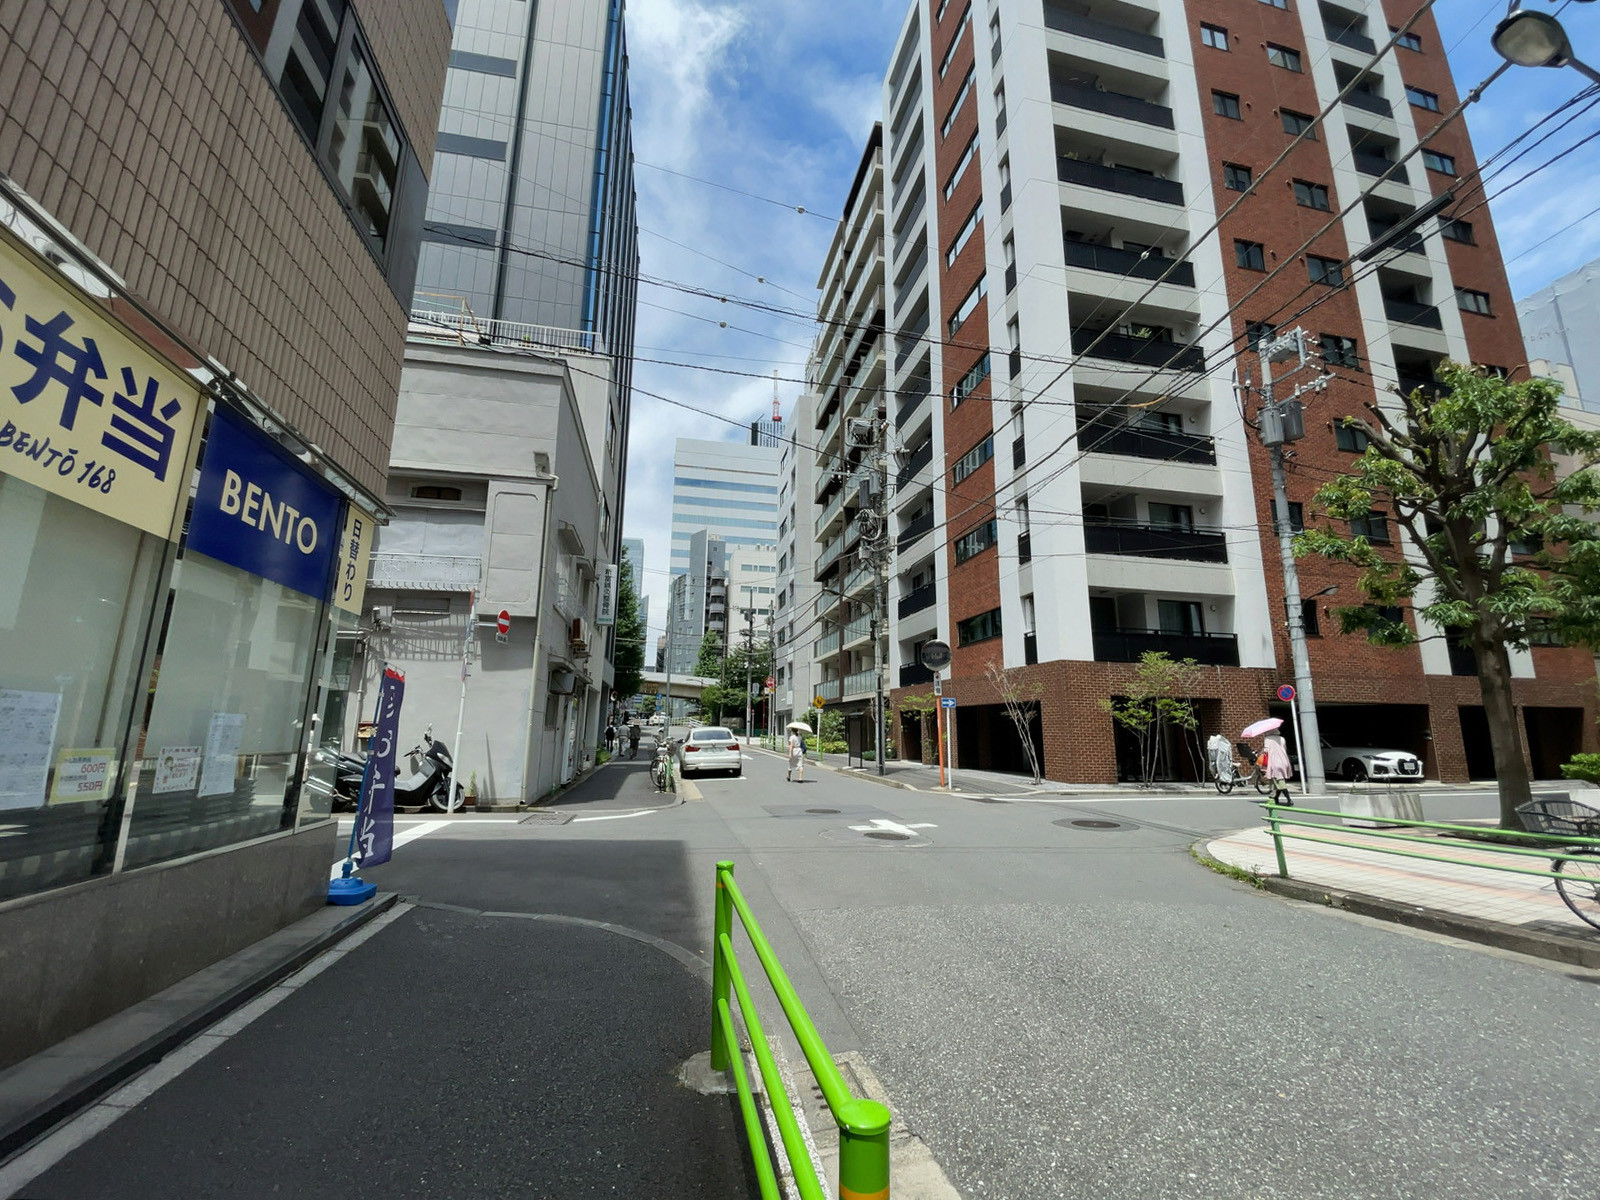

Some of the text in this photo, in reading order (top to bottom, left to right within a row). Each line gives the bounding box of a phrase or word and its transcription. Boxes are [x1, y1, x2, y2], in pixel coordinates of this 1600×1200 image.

[0, 278, 182, 482] 弁当
[77, 460, 116, 494] 168
[219, 468, 318, 555] BENTO
[343, 518, 362, 602] 日替わり
